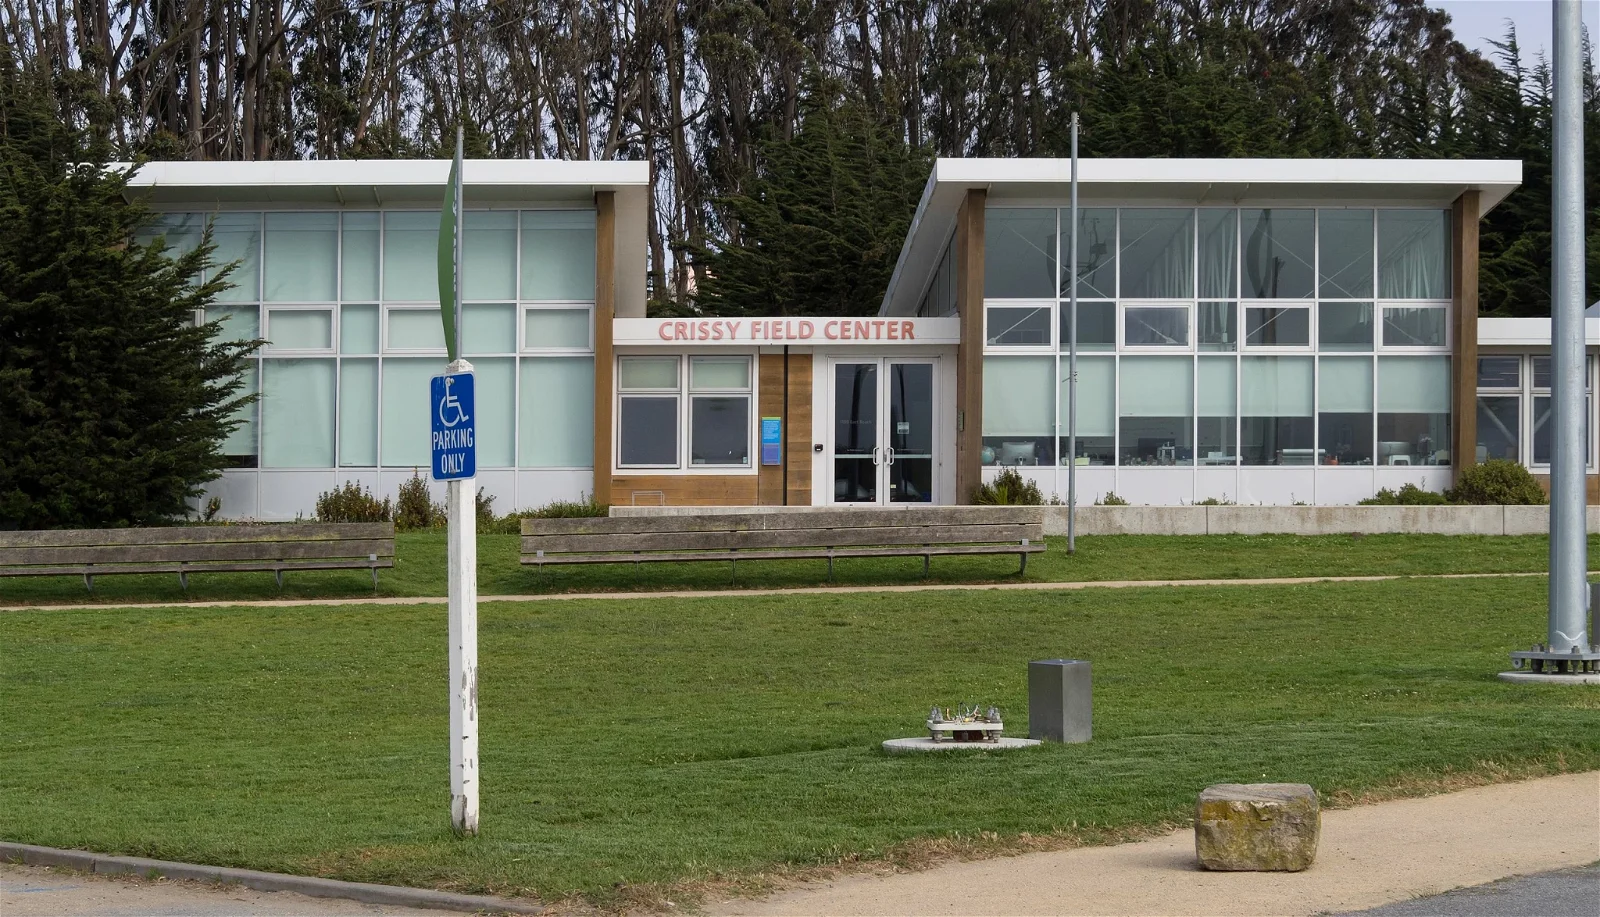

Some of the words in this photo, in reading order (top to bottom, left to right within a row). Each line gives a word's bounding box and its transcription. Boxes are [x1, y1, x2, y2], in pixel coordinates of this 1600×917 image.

[659, 320, 741, 341] CRISSY
[751, 320, 815, 340] FIELD
[824, 320, 915, 340] CENTER
[433, 427, 473, 451] PARKING
[441, 452, 465, 474] ONLY
